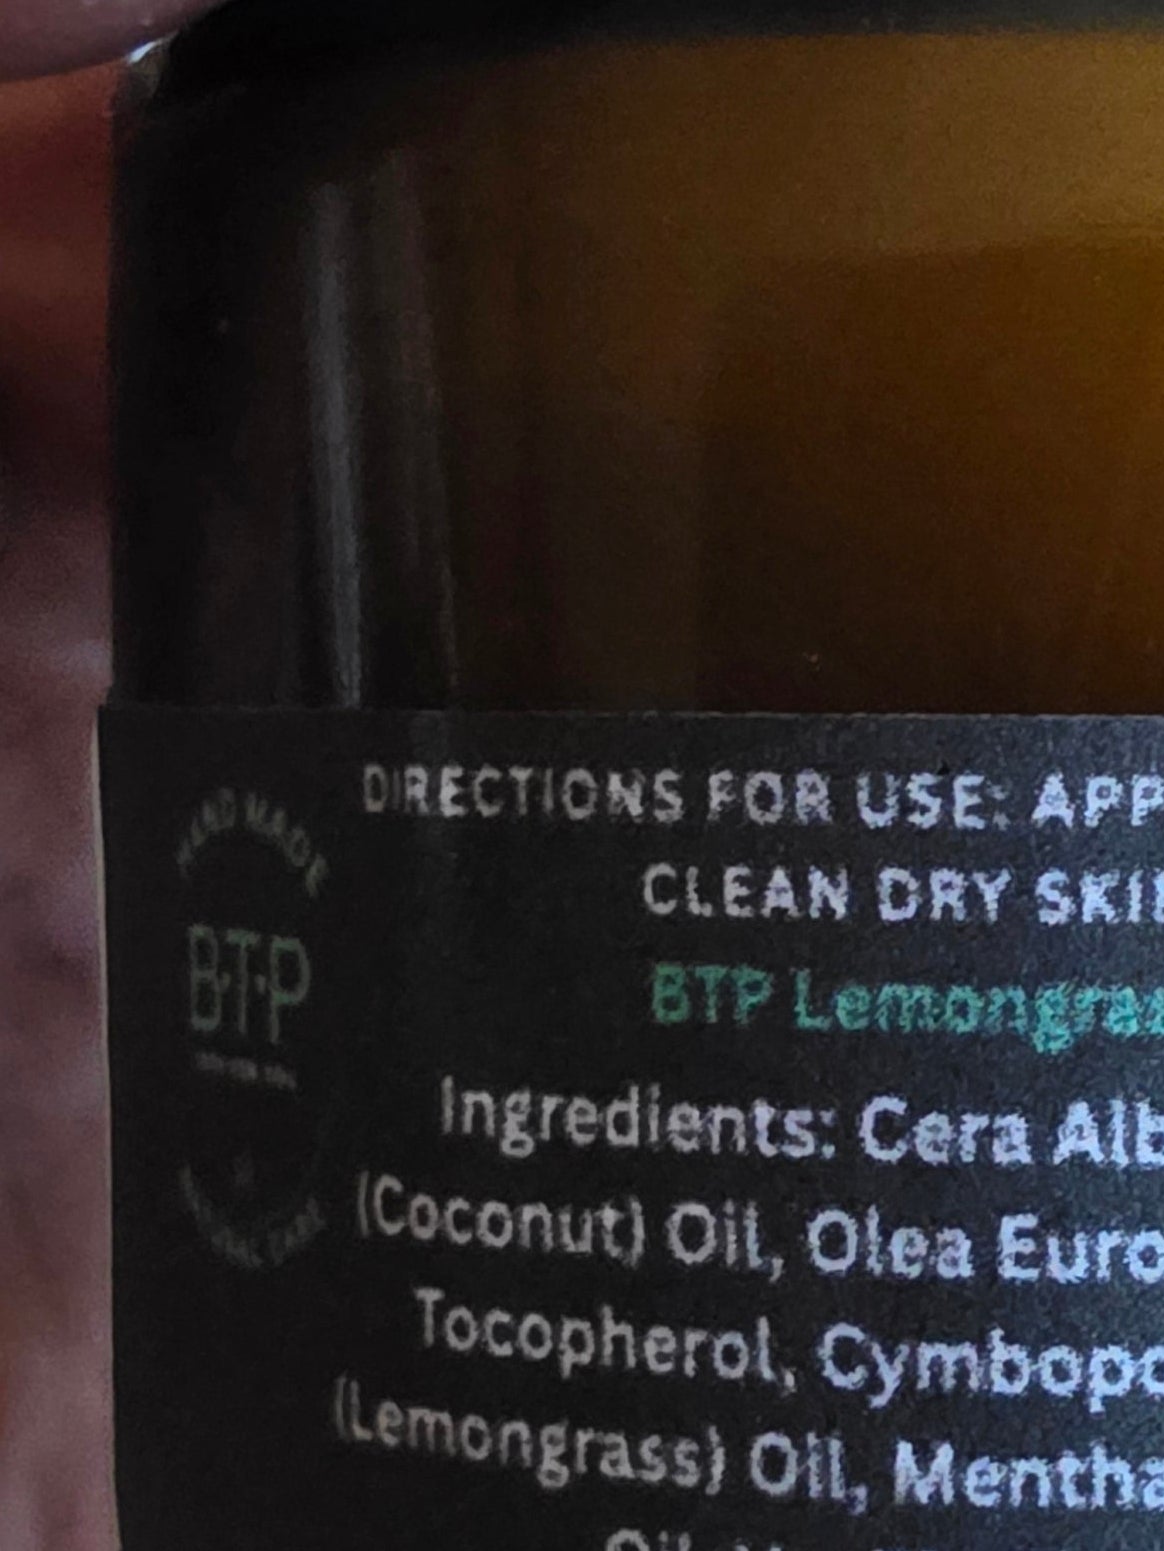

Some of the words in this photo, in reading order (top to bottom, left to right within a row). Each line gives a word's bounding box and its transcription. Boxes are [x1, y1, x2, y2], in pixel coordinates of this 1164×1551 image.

[363, 764, 684, 822] DIRECTIONS
[707, 770, 833, 825] FOR
[857, 772, 1012, 831] USE:
[643, 862, 848, 921] CLEAN
[877, 867, 1012, 923] DRY
[651, 962, 773, 1027] BTP
[440, 1074, 838, 1160] Ingredients:
[859, 1095, 1032, 1165] Cera
[356, 1170, 647, 1268] (Coconut)
[666, 1202, 784, 1282] Oil,
[806, 1205, 973, 1282] Olea
[413, 1286, 797, 1396] Tocopherol,
[333, 1375, 725, 1495] (Lemongrass)
[750, 1429, 869, 1514] Oil,
